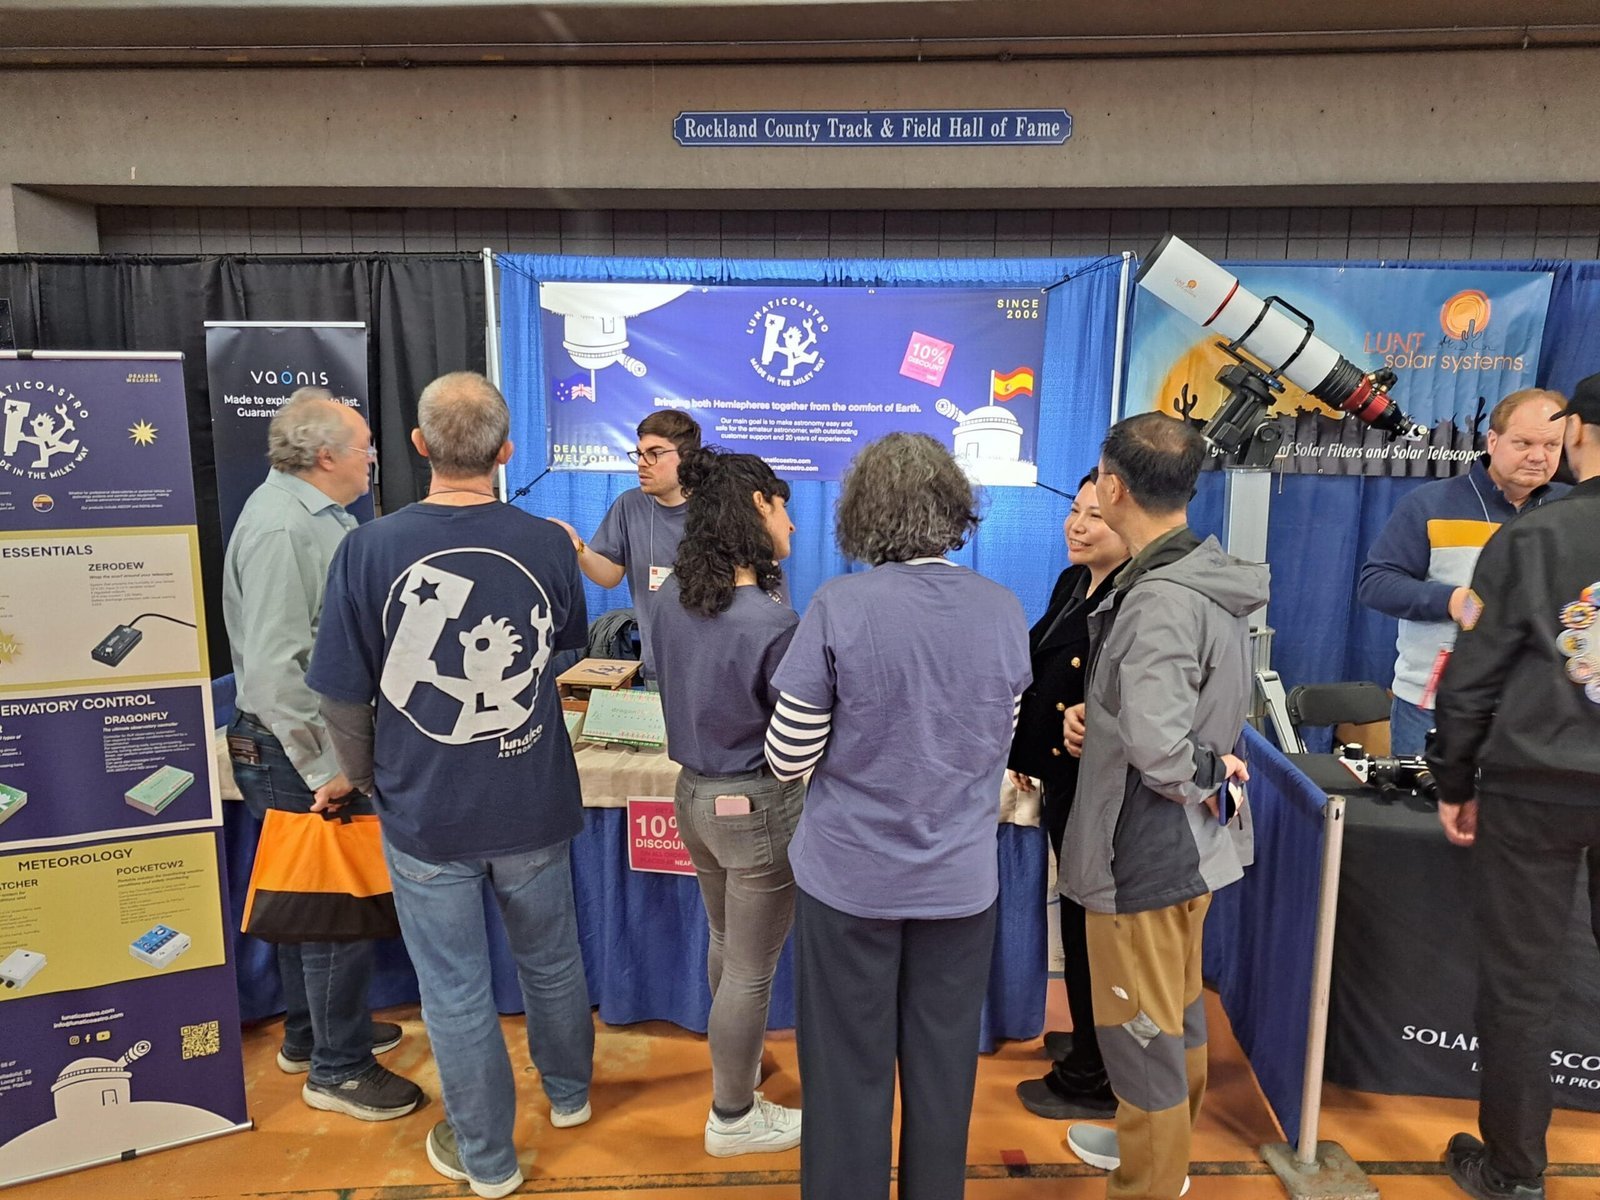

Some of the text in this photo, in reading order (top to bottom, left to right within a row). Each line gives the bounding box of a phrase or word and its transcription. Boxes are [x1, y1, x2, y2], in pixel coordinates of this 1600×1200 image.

[684, 117, 1060, 142] Rockland County Track & Field Hall of Fame
[997, 299, 1039, 308] SINCE
[746, 297, 829, 334] LUNATICOASTRO
[1006, 310, 1038, 319] 2006
[1363, 332, 1426, 354] LUNT
[913, 343, 946, 366] 10%
[1384, 351, 1524, 374] solar systems
[250, 370, 329, 386] vaonis
[750, 357, 826, 387] MADE IN THE MILKY WAY
[0, 381, 88, 418] ATICOASTRO
[224, 395, 252, 405] Made
[254, 395, 264, 405] to
[266, 395, 292, 408] explo
[341, 398, 360, 407] last.
[692, 399, 712, 408] both
[713, 400, 770, 411] Hemispheres
[772, 402, 808, 412] together
[810, 402, 830, 412] from
[832, 402, 846, 412] the
[848, 403, 883, 412] comfort
[884, 403, 894, 412] of
[896, 404, 922, 413] Earth.
[237, 408, 280, 418] Guarant
[748, 418, 762, 426] goal
[776, 418, 792, 426] make
[840, 420, 852, 428] and
[553, 444, 608, 454] DEALERS
[1294, 443, 1324, 458] Solar
[1327, 443, 1363, 458] Filters
[1366, 444, 1388, 459] and
[1392, 444, 1423, 460] Solar
[0, 446, 89, 480] DE IN THE MILKY WAY
[2, 545, 94, 558] ESSENTIALS
[88, 562, 145, 572] ZERODEW
[1, 694, 156, 716] ERVATORY CONTROL
[104, 711, 169, 725] DRAGONFLY
[636, 838, 686, 850] DISCOU
[18, 848, 134, 872] METEOROLOGY
[116, 860, 184, 876] POCKETCW2
[0, 878, 38, 890] TCHER
[1550, 1050, 1600, 1071] SCO
[1569, 1076, 1600, 1090] PRO
